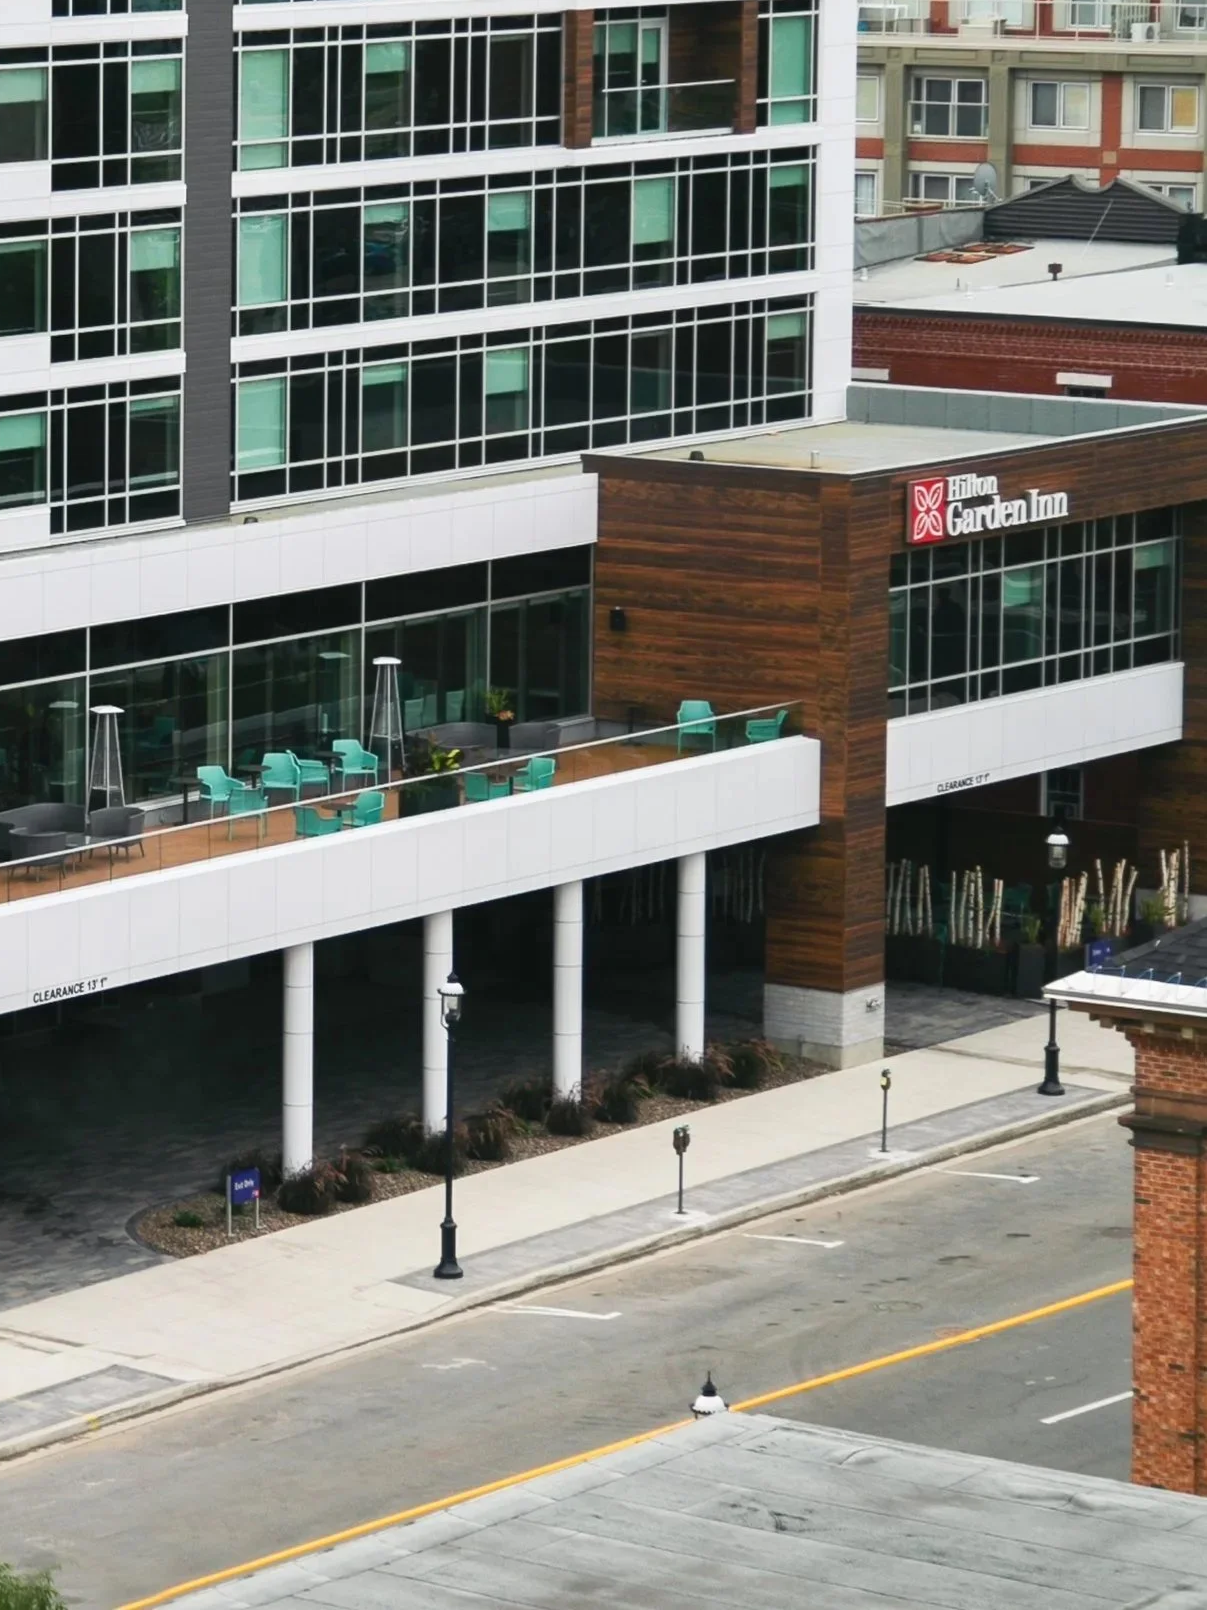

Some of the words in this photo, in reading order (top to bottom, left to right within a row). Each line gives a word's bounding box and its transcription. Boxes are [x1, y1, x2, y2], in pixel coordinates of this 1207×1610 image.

[946, 473, 998, 501] Hilton
[947, 495, 1028, 536] Garden
[1026, 489, 1069, 522] Inn
[937, 776, 973, 793] CLEARANCE
[33, 981, 85, 1003] CLEARANCE
